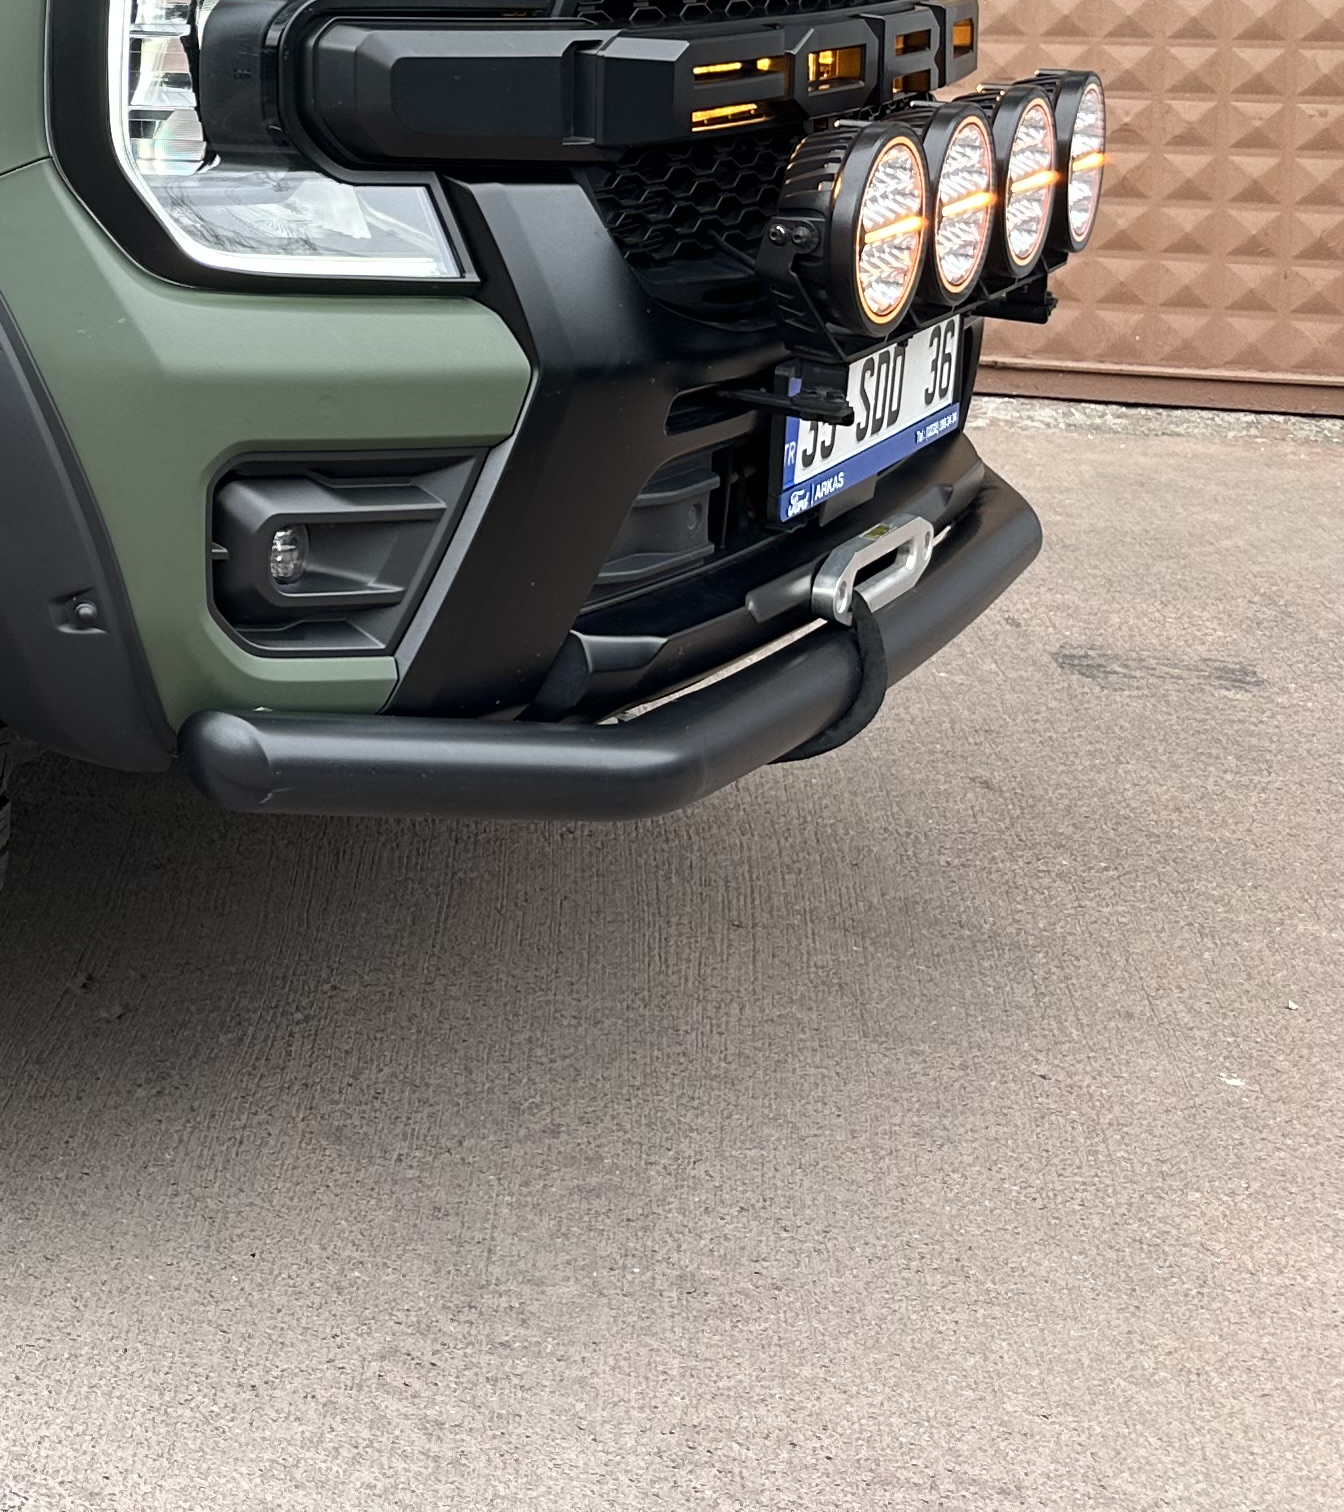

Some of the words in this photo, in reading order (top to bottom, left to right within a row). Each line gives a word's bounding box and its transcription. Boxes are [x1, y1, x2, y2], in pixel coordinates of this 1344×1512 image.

[924, 318, 955, 406] 36
[787, 488, 810, 518] Ford
[814, 471, 845, 501] ARKAS
